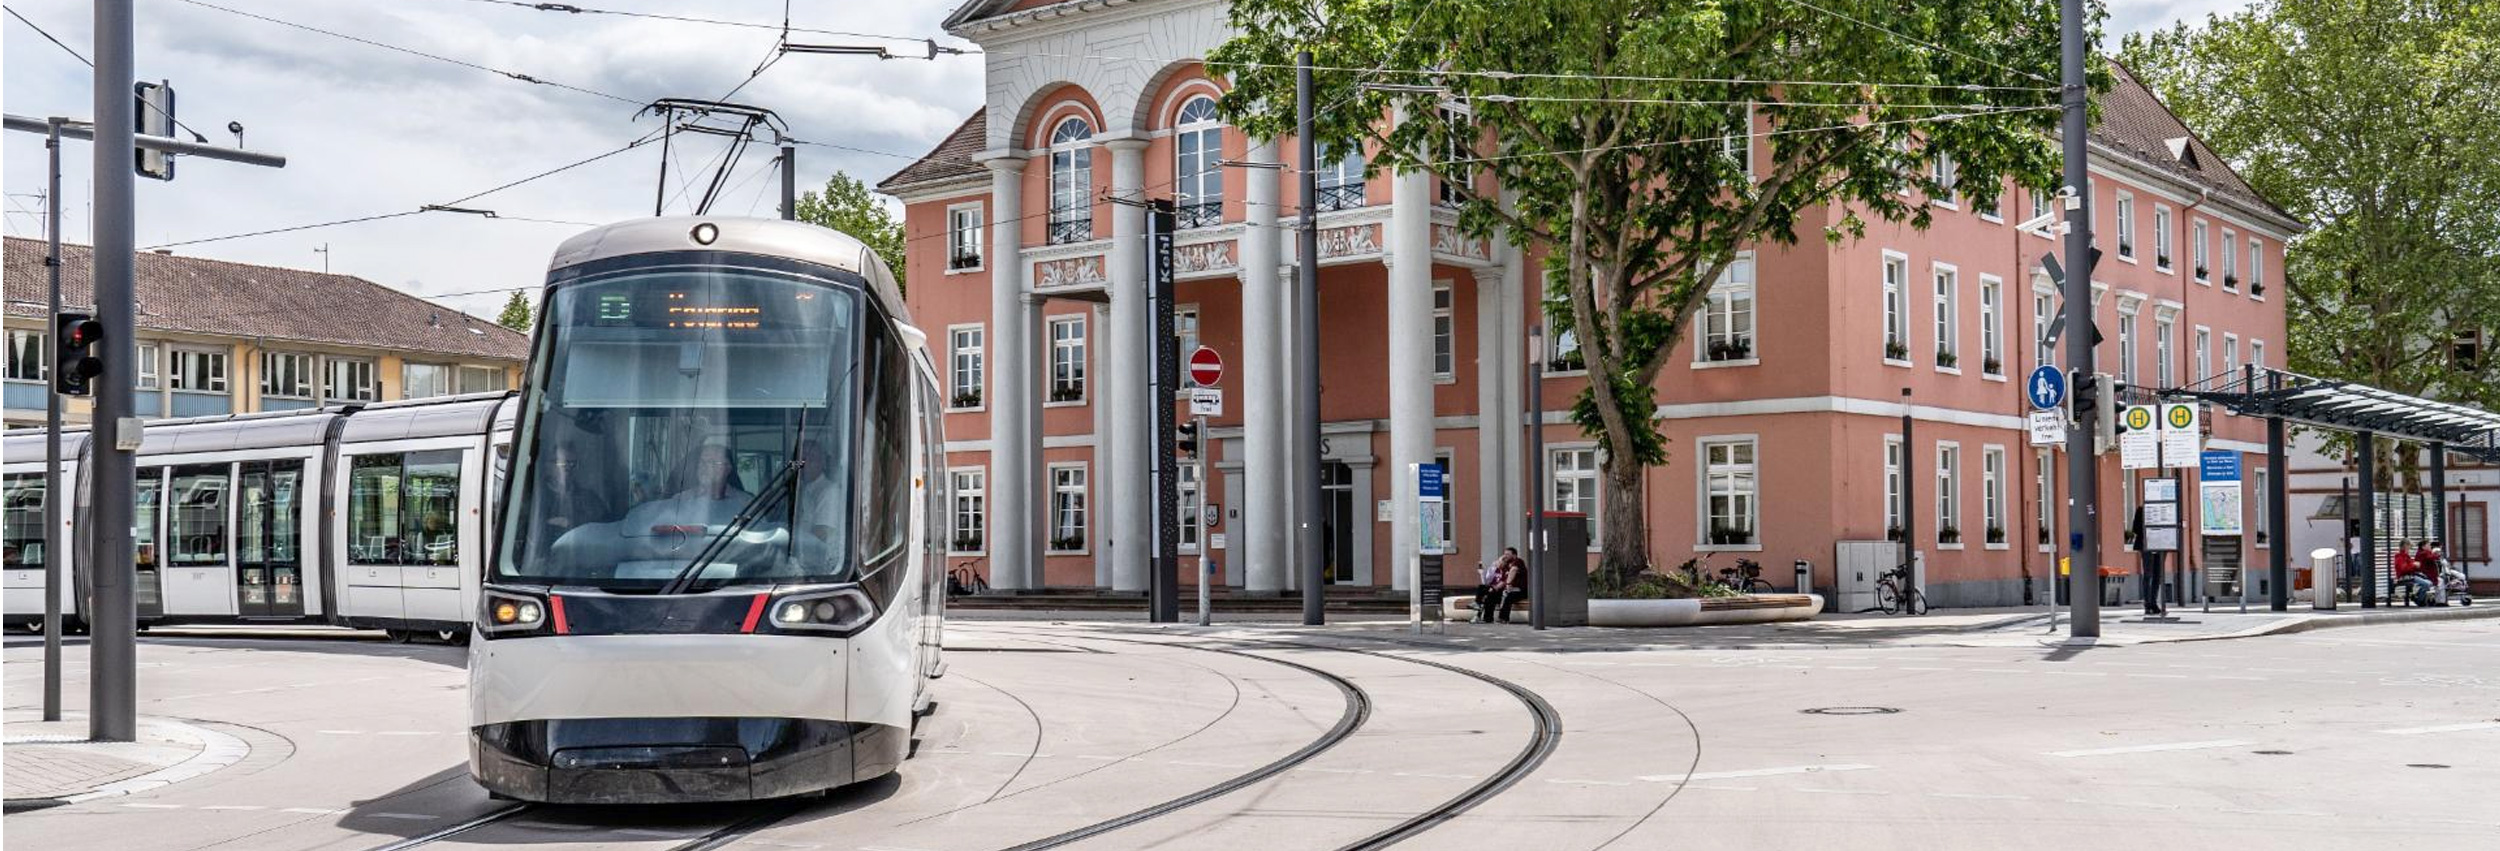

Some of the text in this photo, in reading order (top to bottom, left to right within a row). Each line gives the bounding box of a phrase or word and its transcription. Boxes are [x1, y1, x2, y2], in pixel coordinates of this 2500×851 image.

[1160, 235, 1170, 283] Kehl
[2133, 412, 2144, 425] H
[2174, 410, 2185, 424] H
